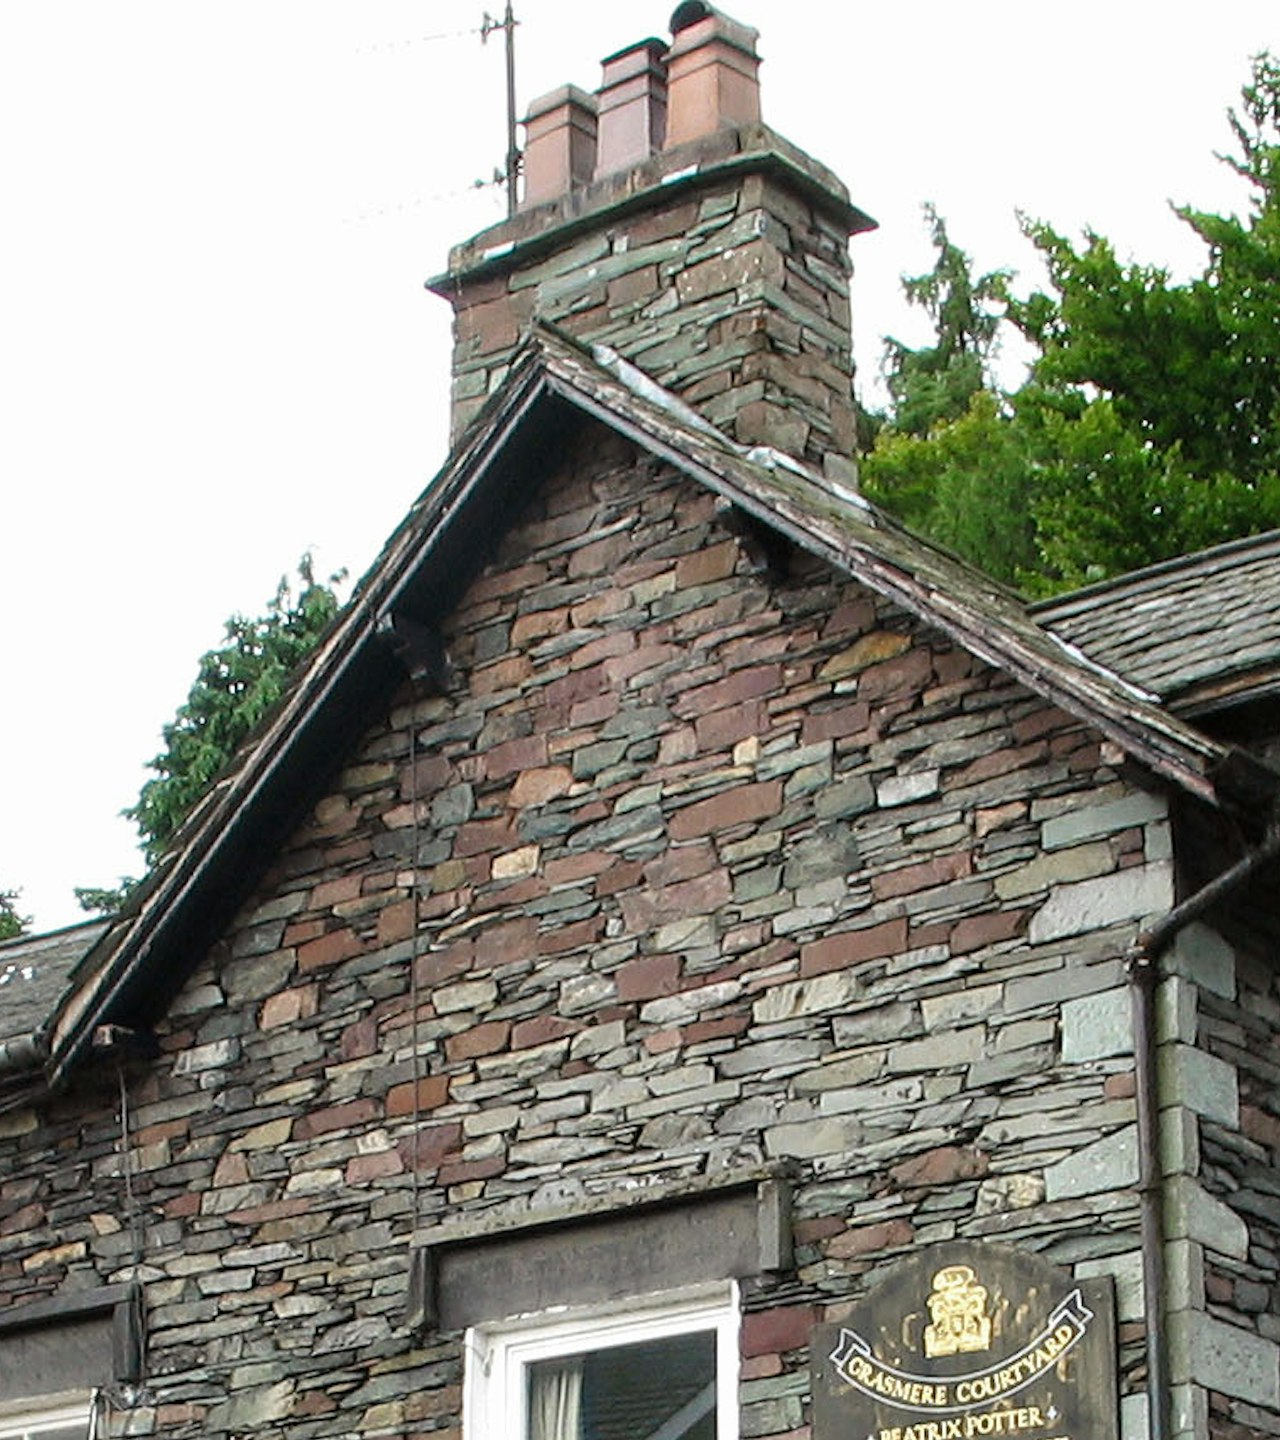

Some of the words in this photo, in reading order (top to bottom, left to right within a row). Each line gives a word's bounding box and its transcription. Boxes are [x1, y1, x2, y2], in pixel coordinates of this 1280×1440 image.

[847, 1354, 947, 1405] GRASMERE
[956, 1325, 1074, 1402] COURTYARD
[965, 1407, 1044, 1438] POTTER
